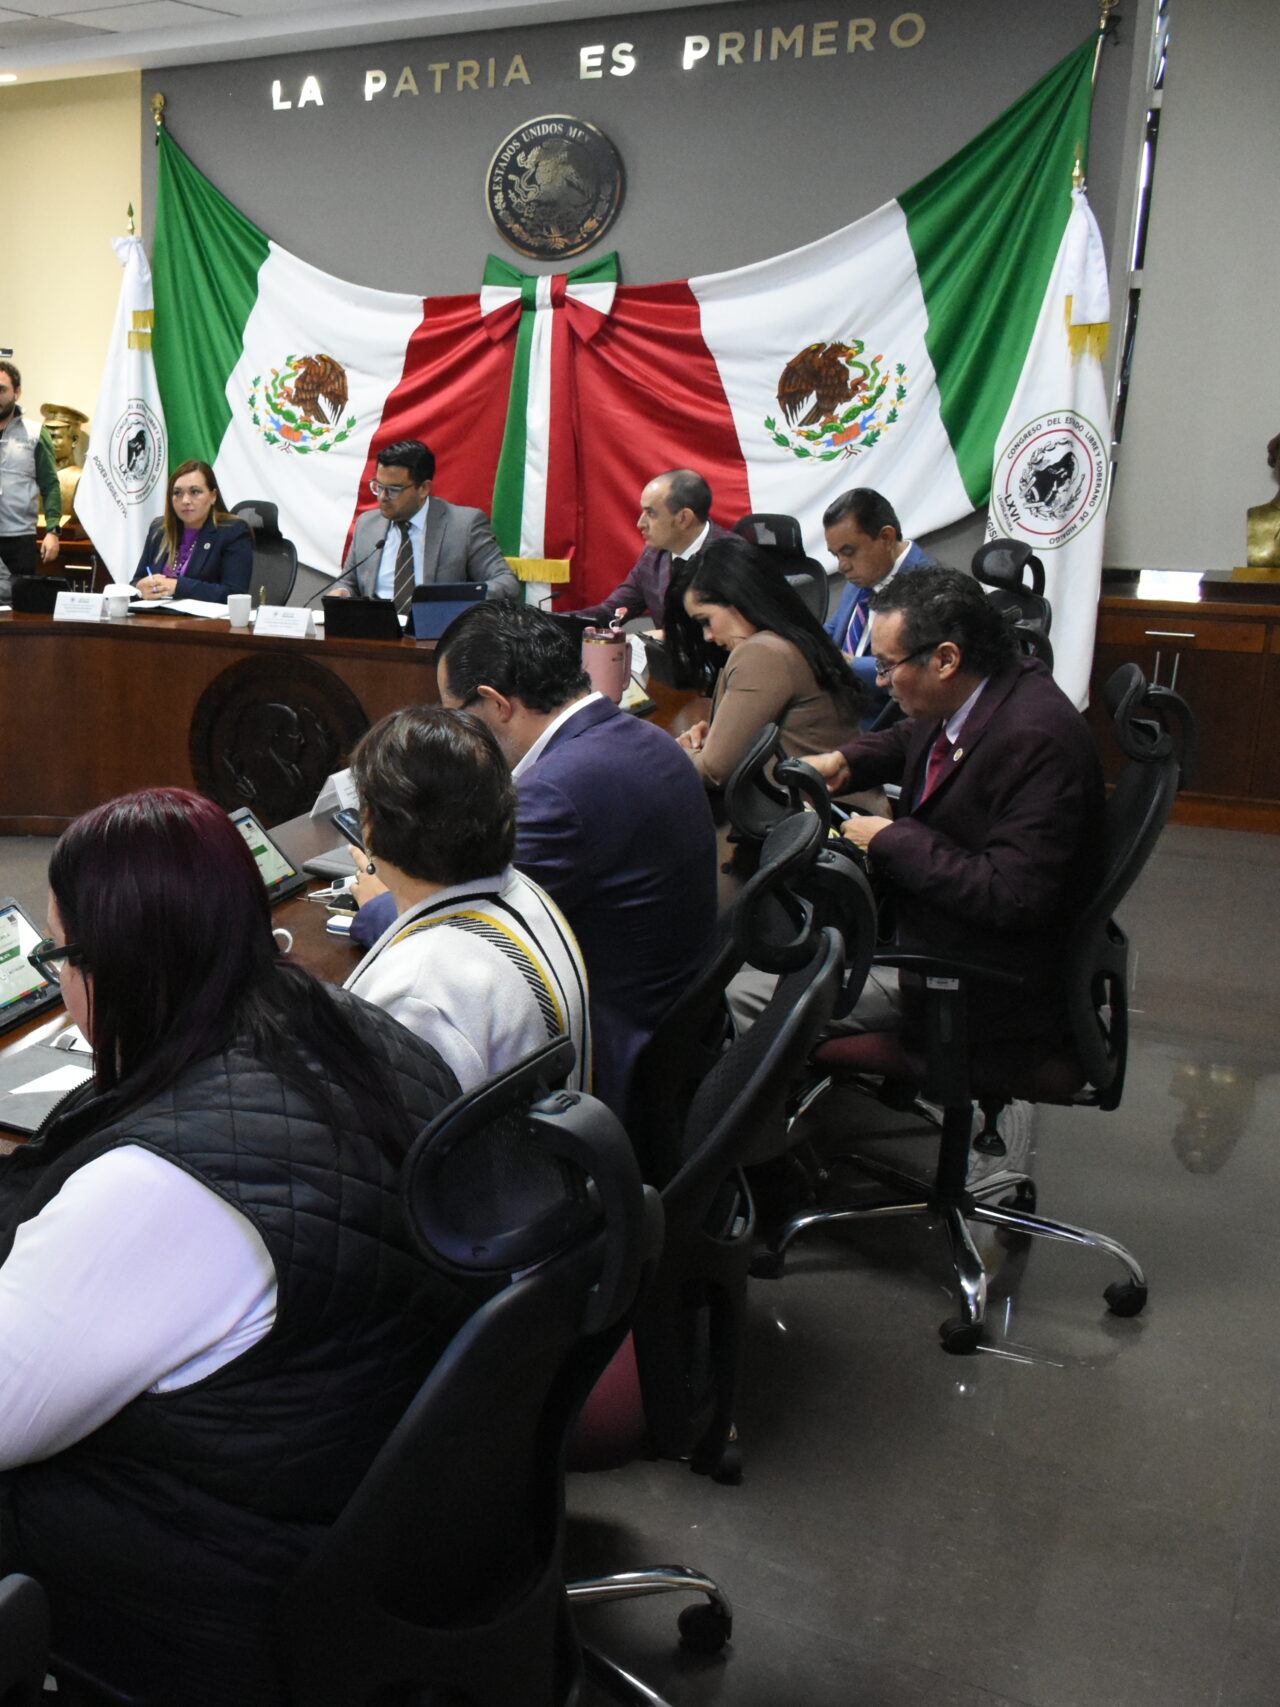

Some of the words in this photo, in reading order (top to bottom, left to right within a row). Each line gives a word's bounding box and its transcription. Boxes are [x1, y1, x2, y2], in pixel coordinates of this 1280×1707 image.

[272, 75, 324, 110] LA
[364, 53, 531, 101] PATRIA
[579, 42, 635, 79] ES
[682, 12, 927, 70] PRIMERO
[492, 139, 521, 190] ESTADOS
[521, 123, 564, 142] UNIDOS
[1047, 417, 1062, 427] DEL
[1007, 424, 1042, 460] CONGRESO
[1085, 432, 1099, 451] LIBRE
[92, 455, 107, 480] PODER
[1088, 460, 1104, 508] SOBERANO
[1004, 494, 1020, 522] LXVI
[1080, 511, 1088, 522] DE
[1049, 524, 1078, 545] HIDALGO
